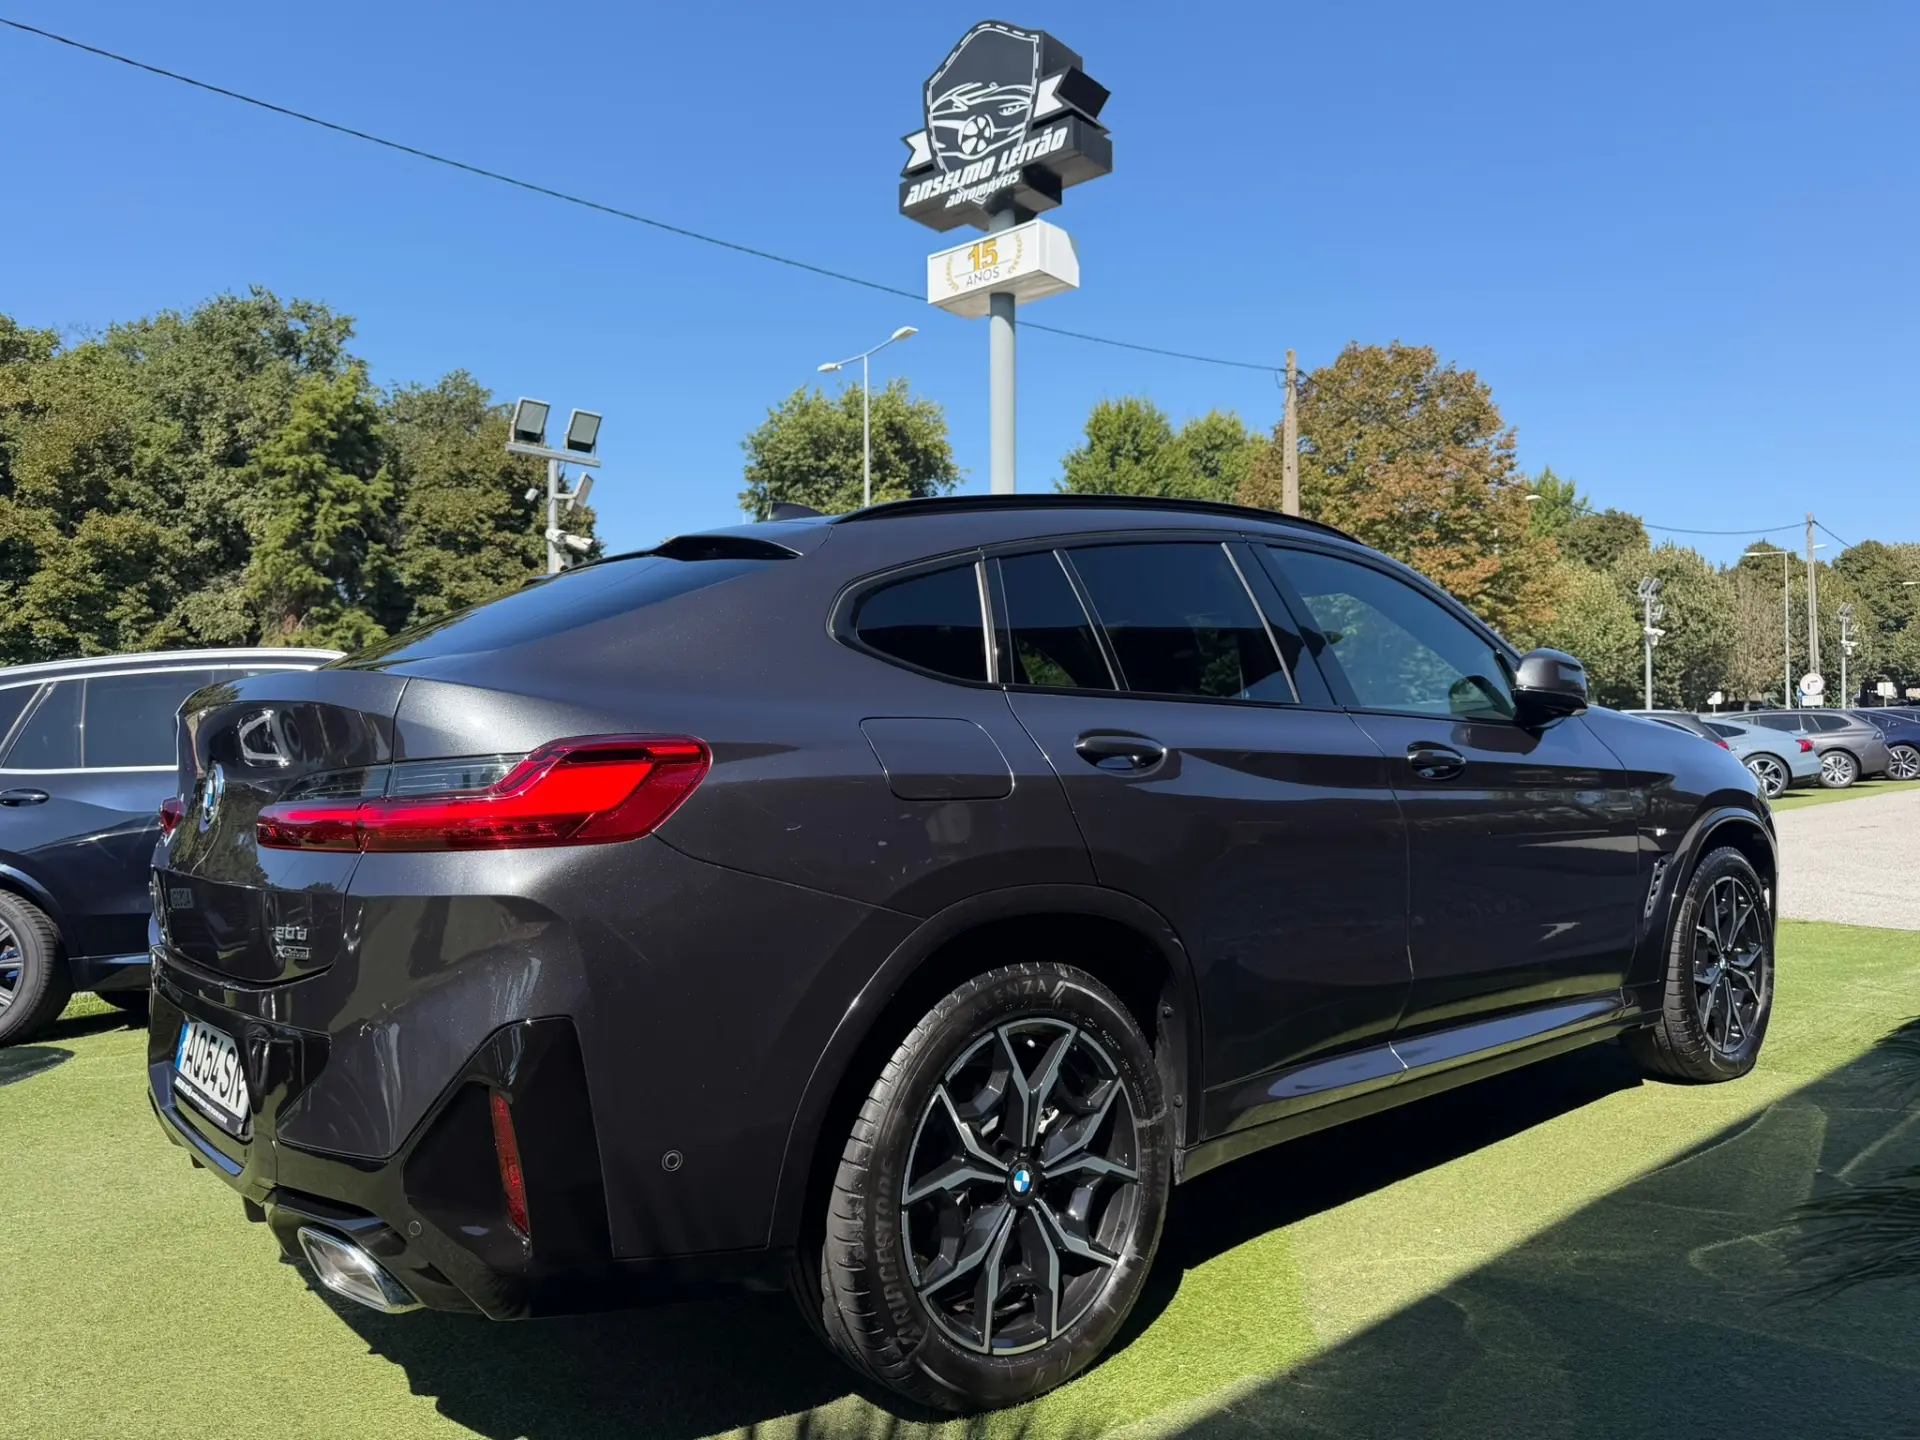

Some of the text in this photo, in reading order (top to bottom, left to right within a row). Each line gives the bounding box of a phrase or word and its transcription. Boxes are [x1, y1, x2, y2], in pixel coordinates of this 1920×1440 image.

[903, 126, 1068, 207] ANSELMO LEITÃO
[967, 238, 998, 271] 15
[966, 267, 1000, 287] ANOS
